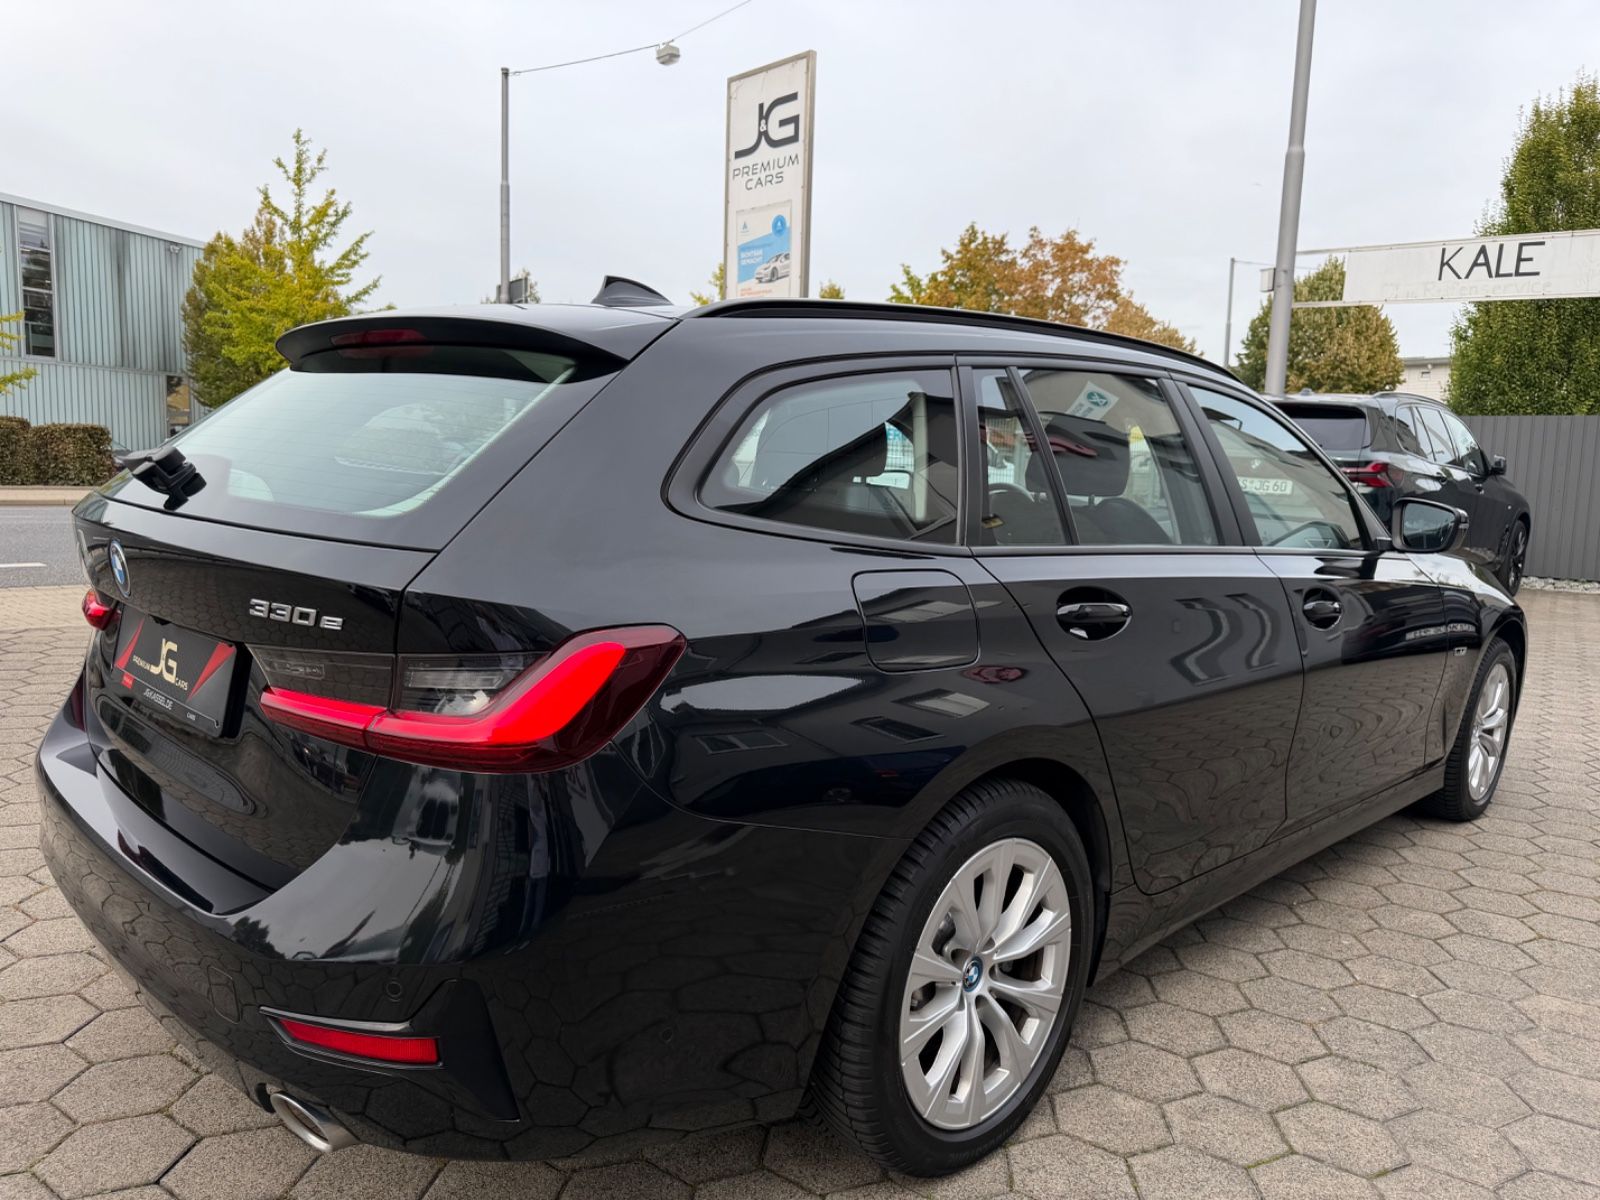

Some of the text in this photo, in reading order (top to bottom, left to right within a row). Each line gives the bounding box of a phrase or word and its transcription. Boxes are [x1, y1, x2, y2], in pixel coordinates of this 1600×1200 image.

[732, 153, 800, 180] PREMIUM
[745, 171, 784, 191] CARS
[1438, 241, 1546, 281] KALE
[1272, 480, 1288, 492] 60
[175, 678, 188, 691] CARS
